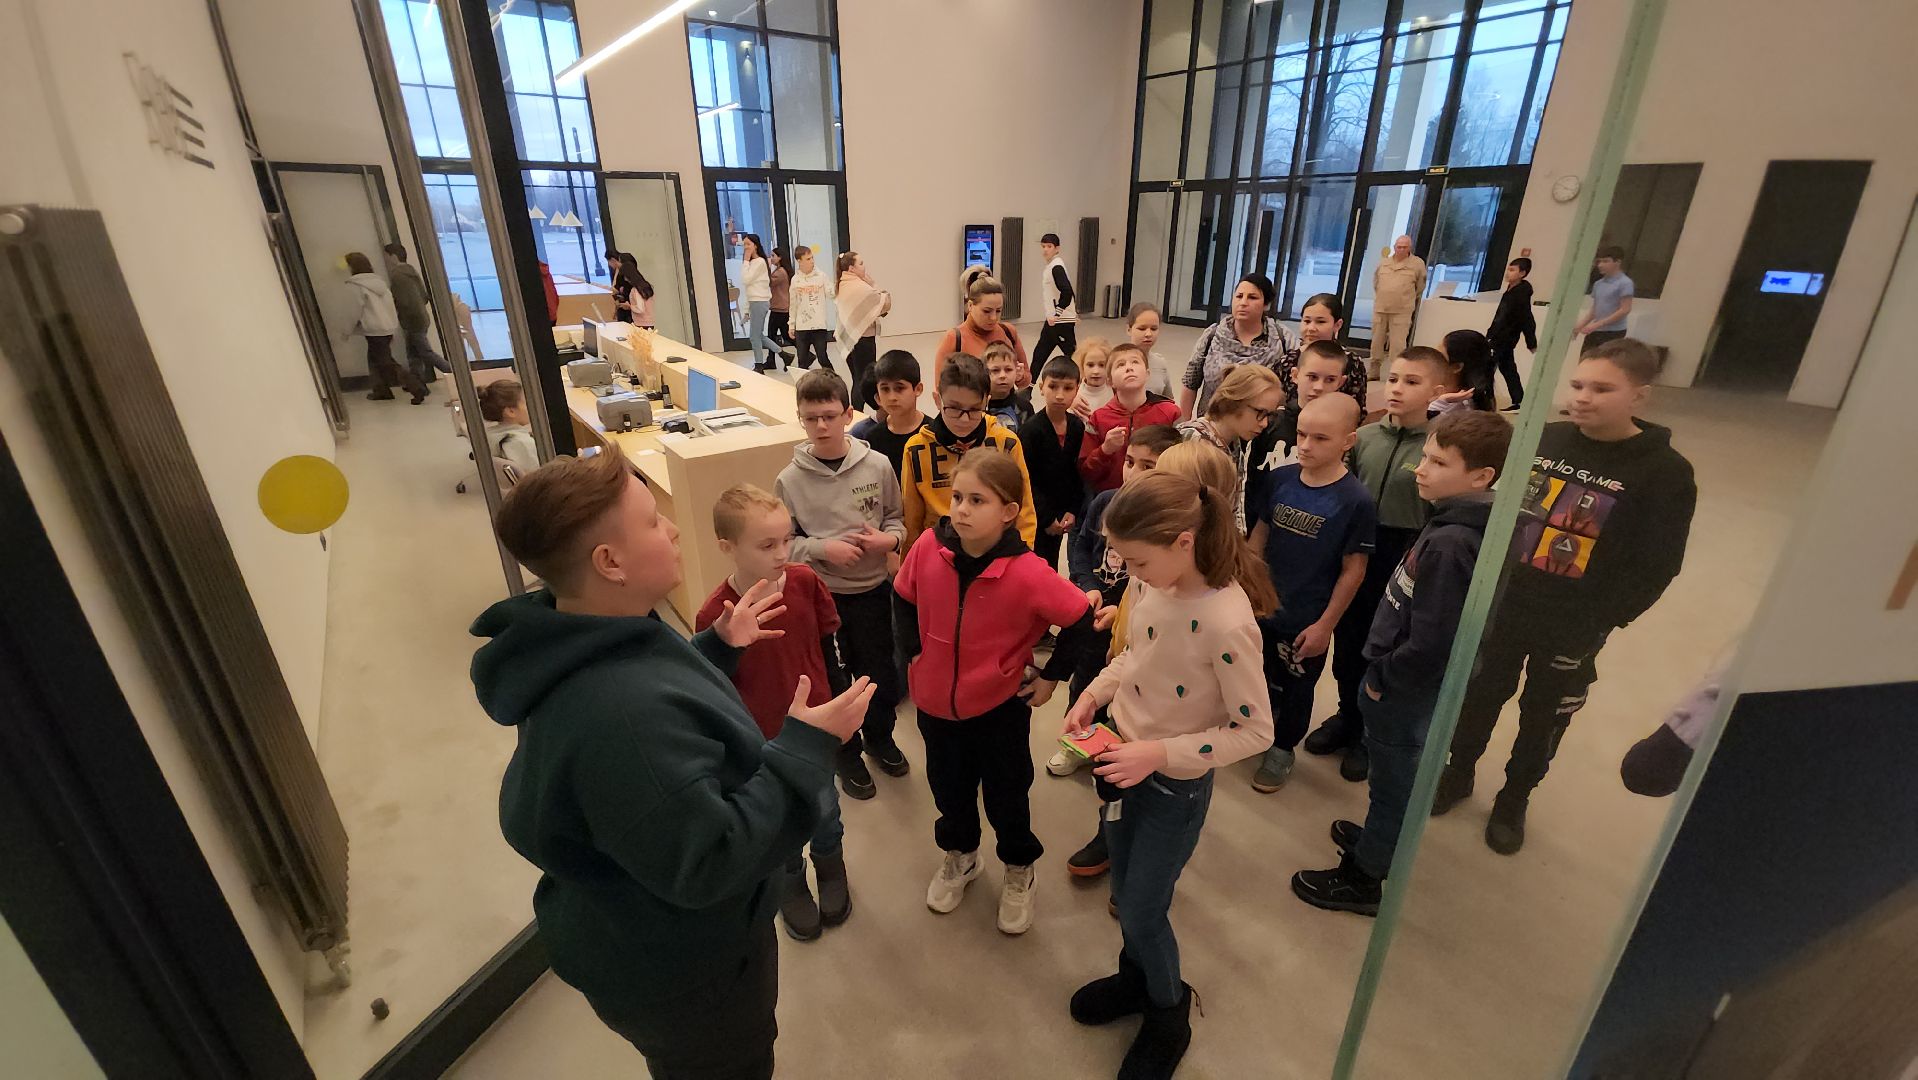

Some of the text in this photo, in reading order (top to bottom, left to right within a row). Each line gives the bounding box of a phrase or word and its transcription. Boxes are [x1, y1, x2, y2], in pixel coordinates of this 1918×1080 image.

[851, 482, 879, 496] ATHLETIC
[1533, 456, 1625, 491] SQUID GAME
[1273, 502, 1327, 534] ACTIVE
